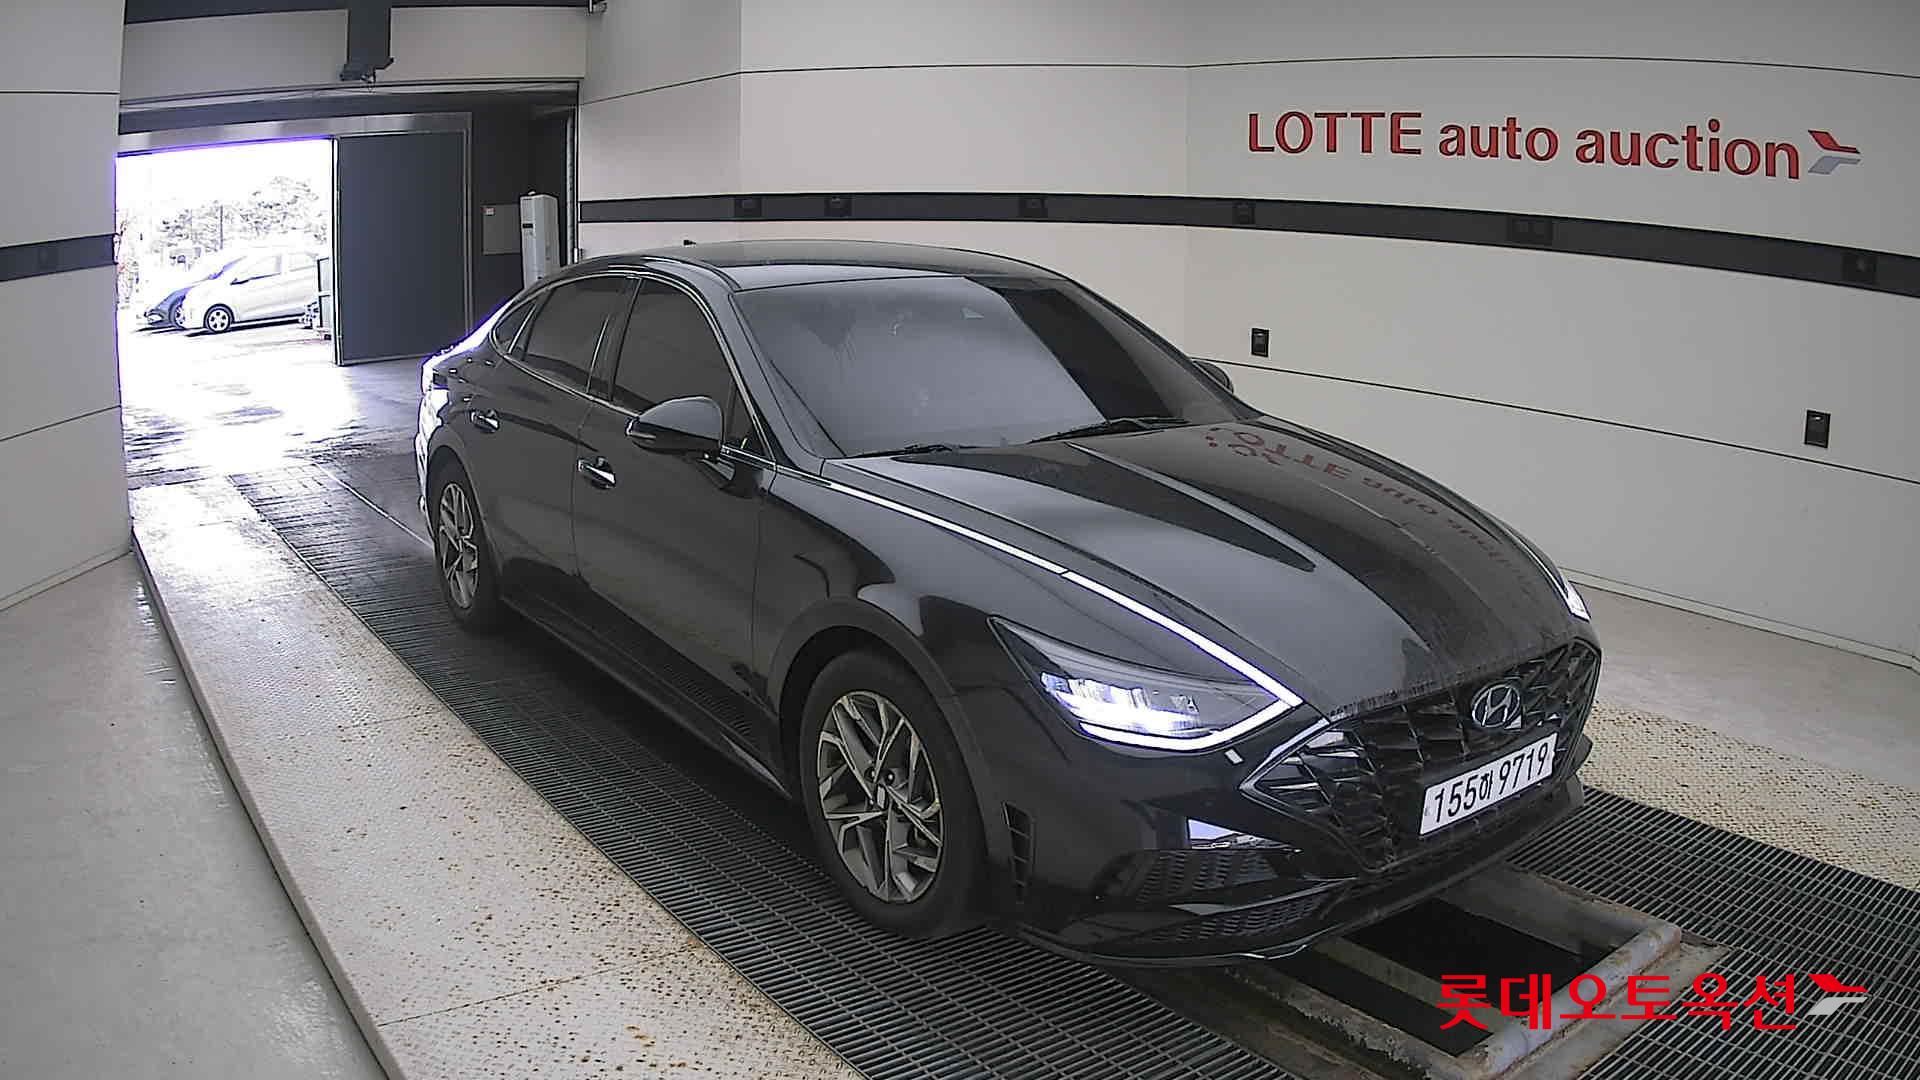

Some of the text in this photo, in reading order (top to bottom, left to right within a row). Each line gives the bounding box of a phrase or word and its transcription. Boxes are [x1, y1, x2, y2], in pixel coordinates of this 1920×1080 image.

[1248, 111, 1800, 179] LOTTE auto auction
[1434, 742, 1549, 823] 155하 9719
